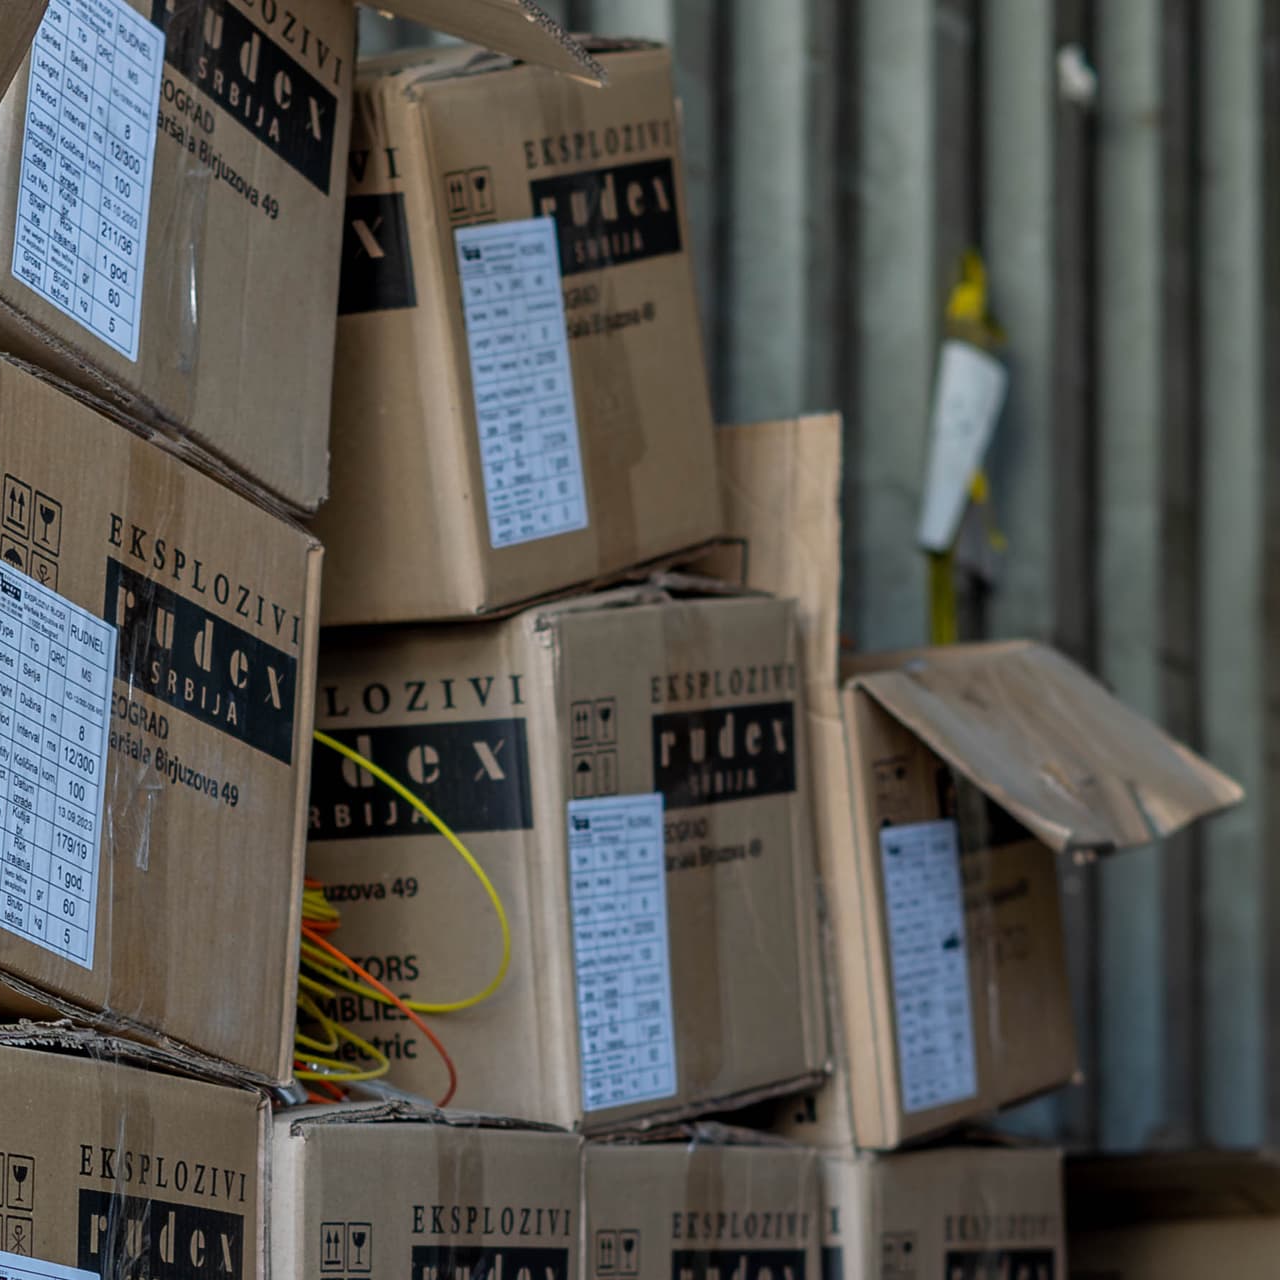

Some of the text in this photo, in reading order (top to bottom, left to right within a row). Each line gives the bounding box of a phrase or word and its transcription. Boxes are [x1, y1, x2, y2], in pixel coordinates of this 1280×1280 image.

[198, 58, 282, 144] SRBIJA
[525, 119, 674, 170] EKSPLOZIVI
[101, 221, 133, 255] 211/36
[108, 513, 301, 646] EKSPLOZIVI
[120, 585, 284, 710] rudex
[151, 661, 239, 726] SRBIJA
[651, 663, 796, 702] EKSPLOZIVI
[63, 746, 95, 775] 12/300
[661, 713, 787, 768] rudex
[154, 745, 240, 807] Birjuzova 49
[56, 832, 87, 860] 179/19
[391, 876, 419, 899] 49
[80, 1144, 248, 1202] EKSPLOZIVI
[89, 1207, 235, 1274] rudex
[412, 1205, 572, 1238] EKSPLOZIVI
[672, 1210, 810, 1241] EKSPLOZIVI
